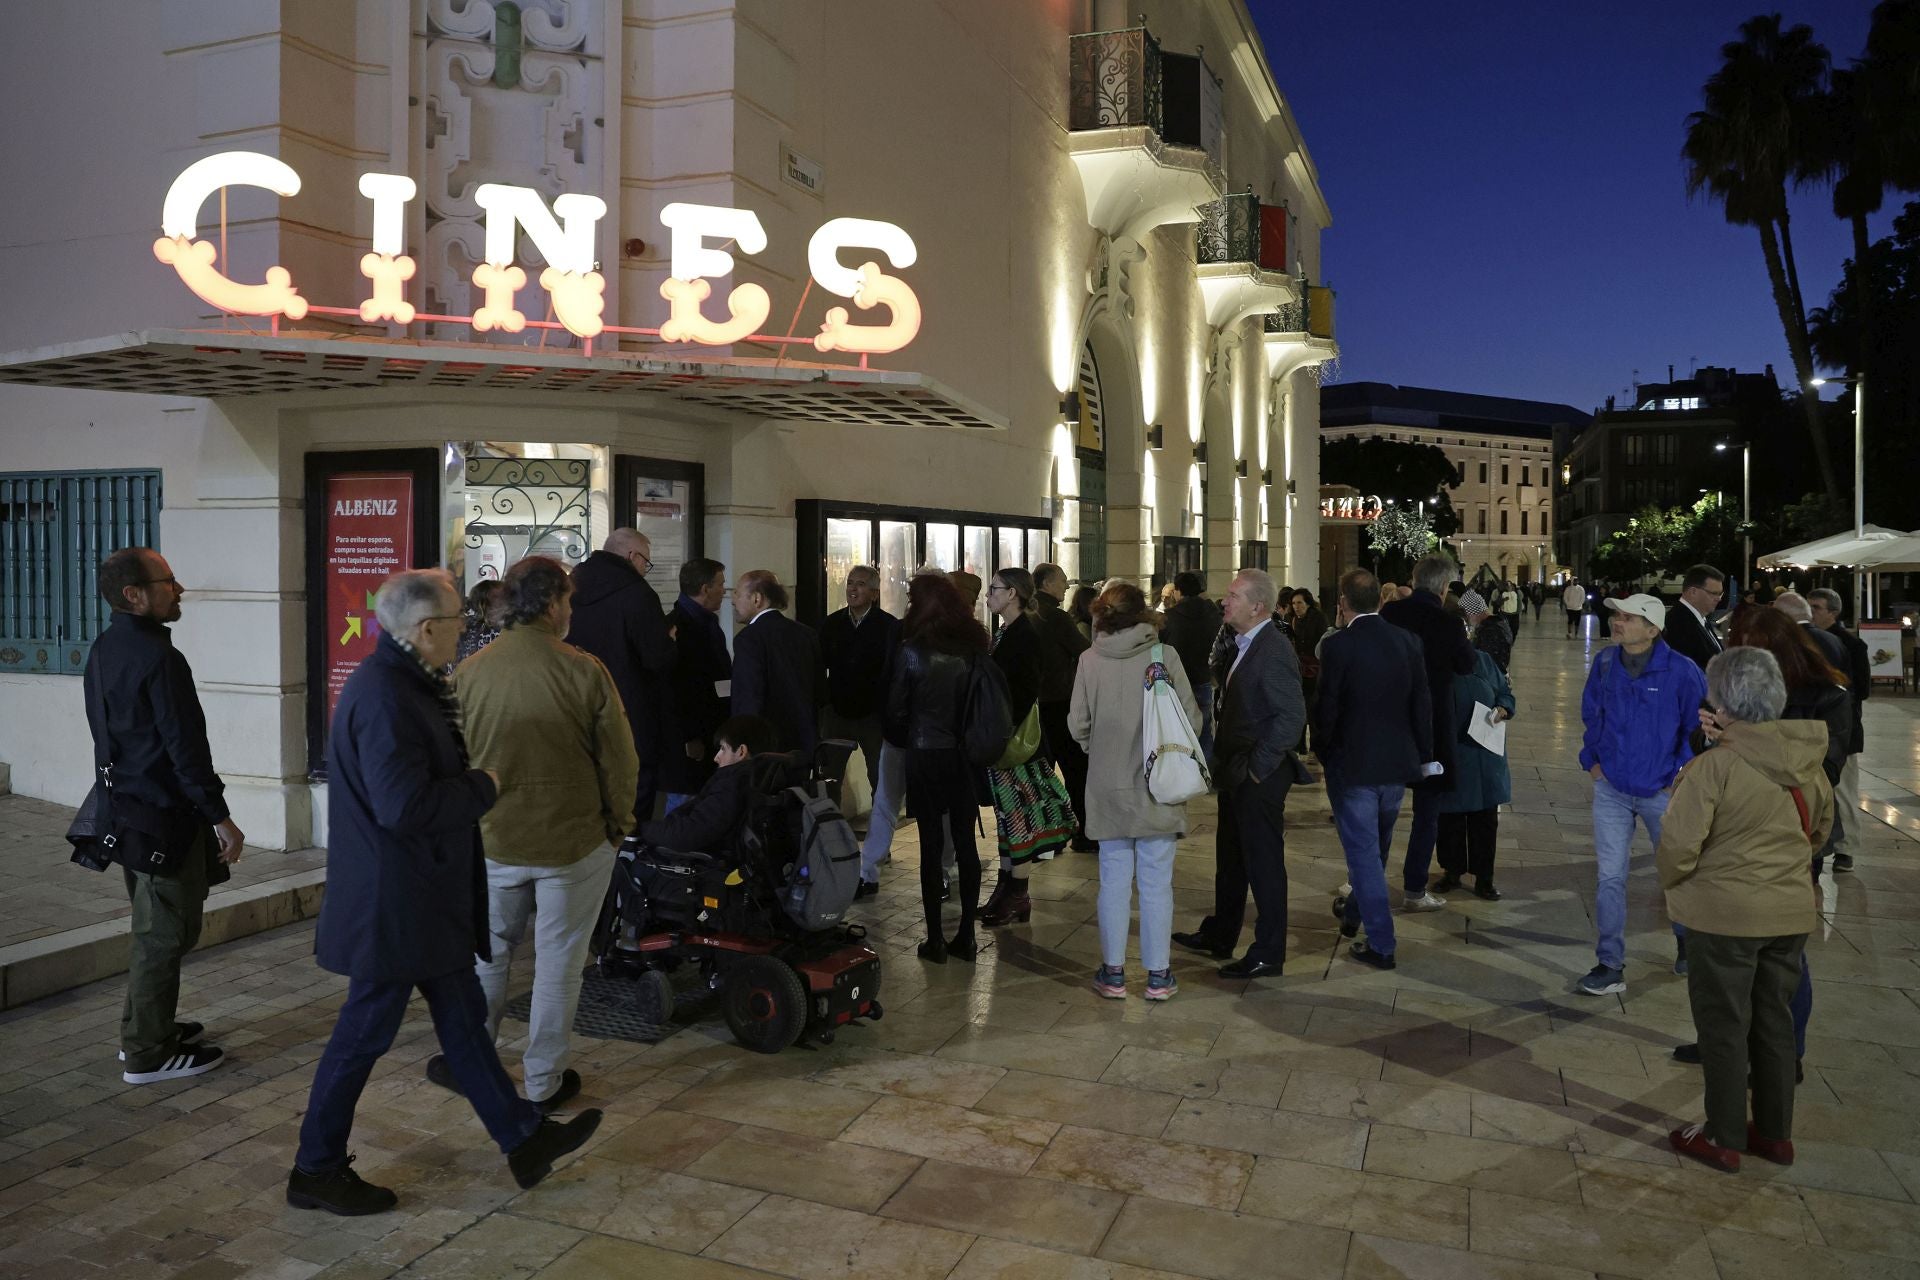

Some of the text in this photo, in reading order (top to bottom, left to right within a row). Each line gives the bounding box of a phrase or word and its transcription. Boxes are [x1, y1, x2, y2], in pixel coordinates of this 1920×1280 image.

[153, 151, 921, 353] CINES
[335, 535, 349, 543] Para
[334, 547, 356, 555] compre
[337, 556, 347, 564] las
[347, 556, 373, 565] taquillas
[373, 557, 399, 565] digitales
[338, 566, 362, 574] situadas
